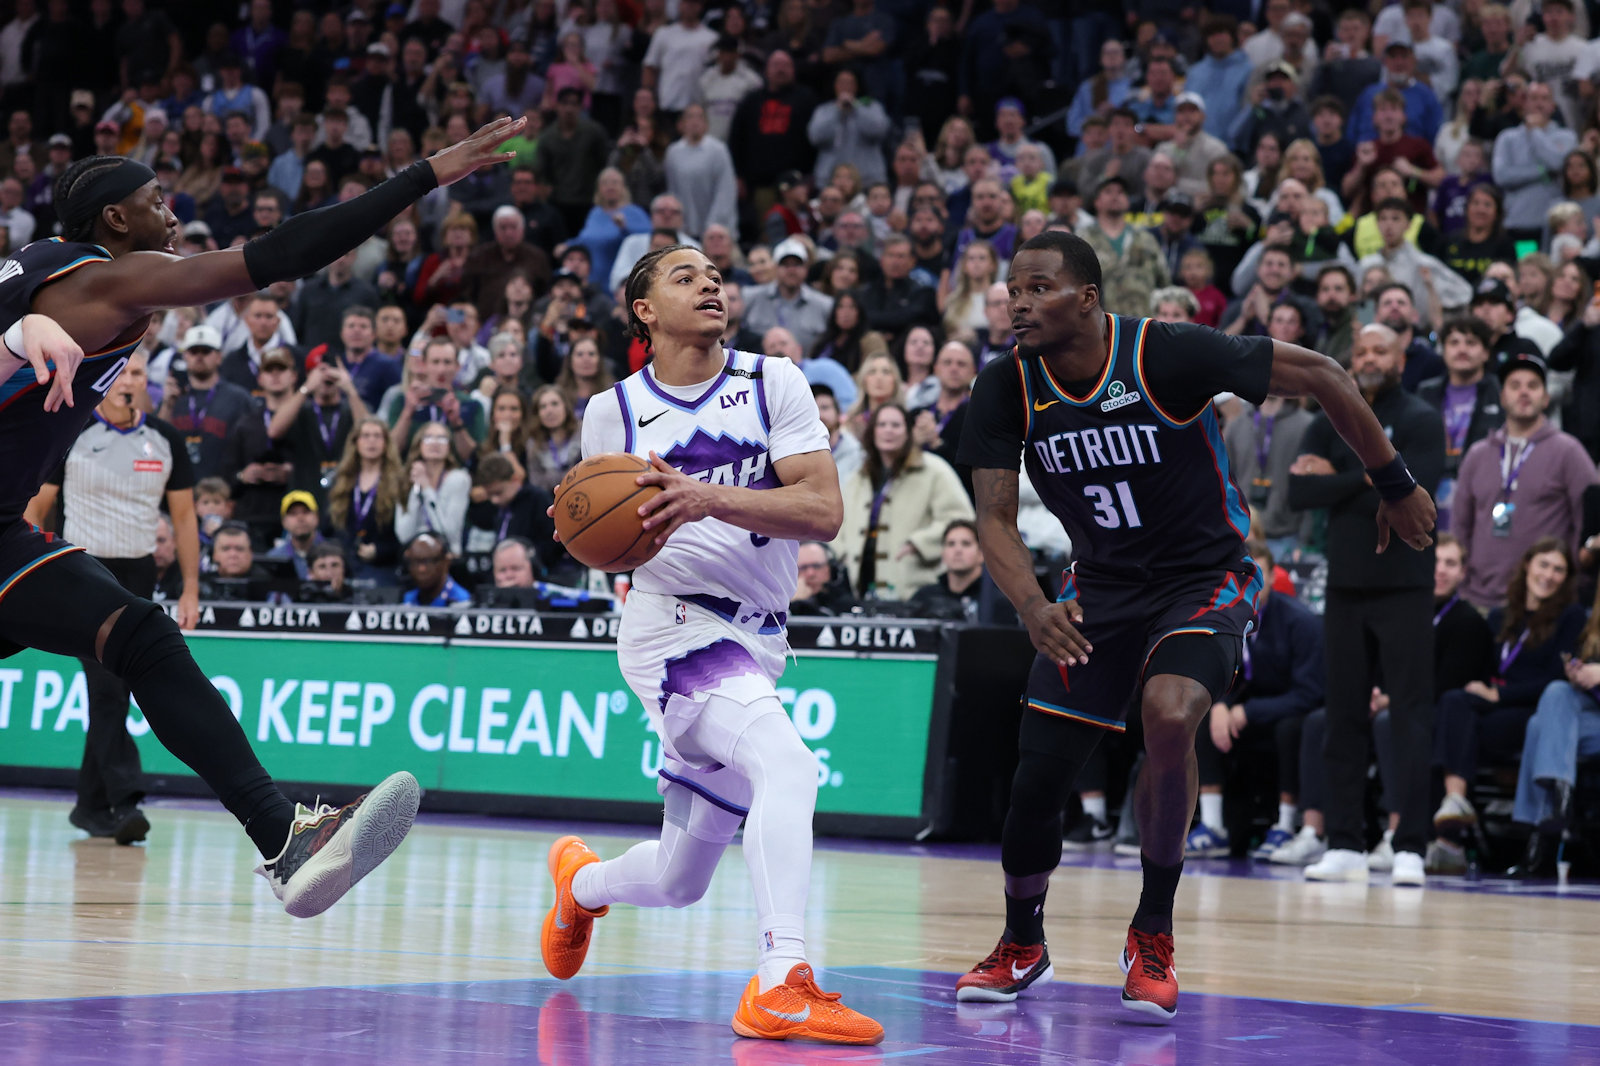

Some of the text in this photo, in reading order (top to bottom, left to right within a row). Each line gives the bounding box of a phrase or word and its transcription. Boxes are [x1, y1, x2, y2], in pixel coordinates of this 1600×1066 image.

[719, 390, 750, 409] LVT
[1102, 392, 1139, 411] StockX
[1033, 424, 1161, 474] DETROIT
[676, 450, 768, 489] TAH
[1083, 480, 1143, 529] 31
[259, 606, 320, 627] DELTA
[366, 610, 430, 631] DELTA
[476, 615, 543, 635] DELTA
[840, 625, 917, 648] DELTA
[257, 678, 396, 747] KEEP
